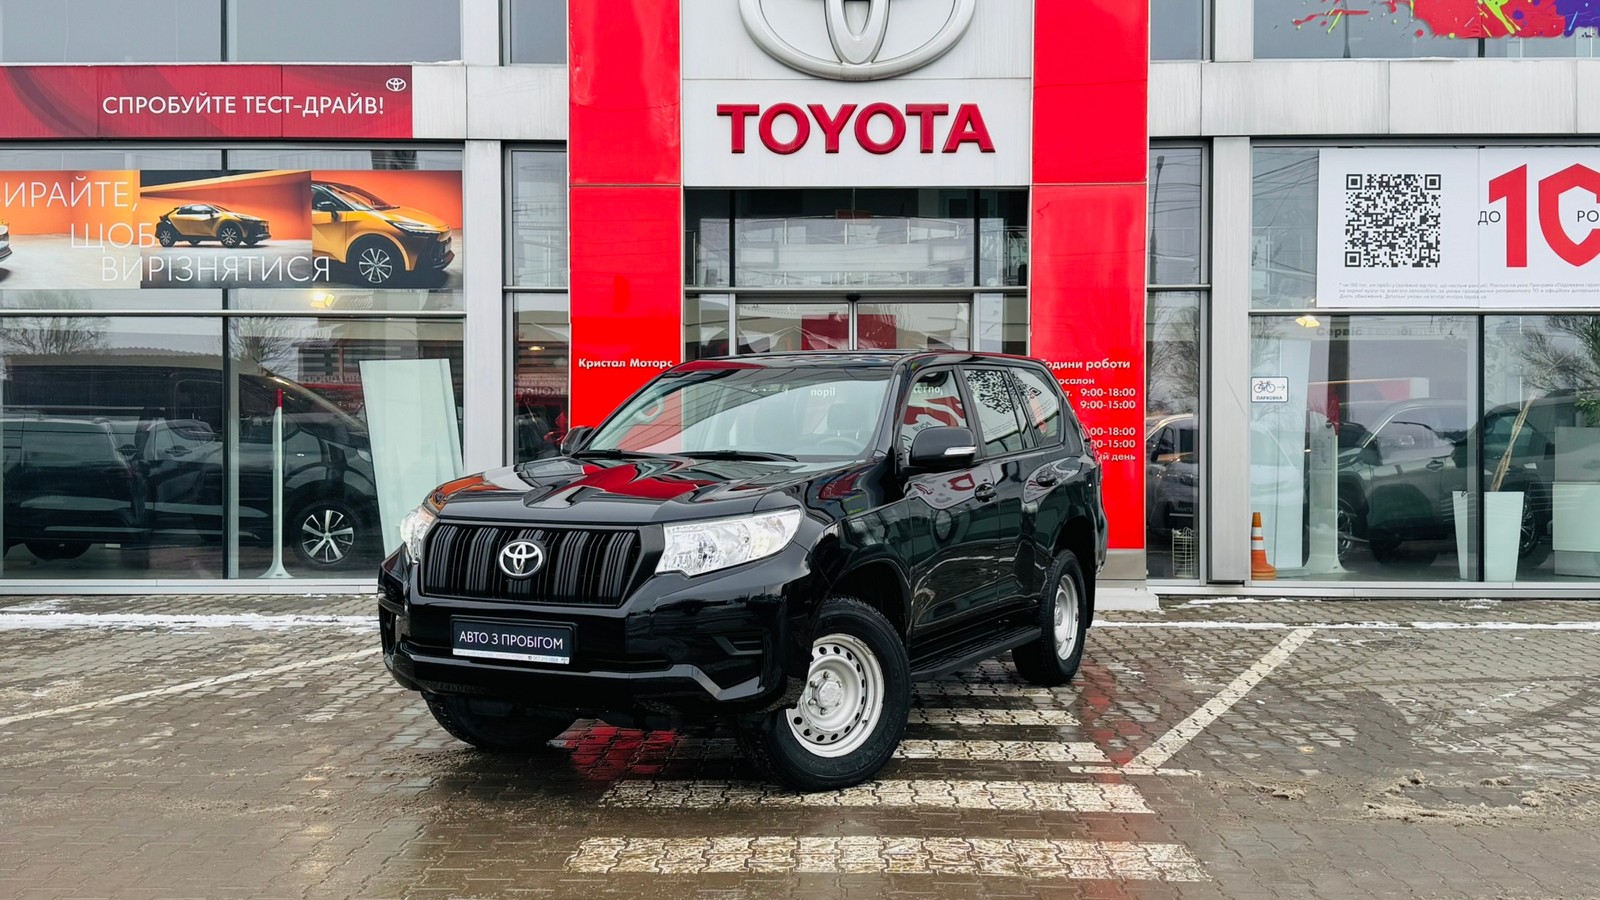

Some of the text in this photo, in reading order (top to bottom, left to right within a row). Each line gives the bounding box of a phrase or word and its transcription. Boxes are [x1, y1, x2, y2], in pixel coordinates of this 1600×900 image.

[102, 92, 384, 117] СПРОБУЙТЕ ТЕСТ-ДРАЙВ!
[716, 102, 996, 155] TOYOTA
[5, 176, 137, 212] ИРАЙТЕ,
[1478, 210, 1501, 226] ДО
[71, 222, 156, 253] ЩОБ
[102, 256, 331, 283] ВИРІЗНЯТИСЯ
[578, 358, 673, 370] Кристал Моторс
[1086, 358, 1131, 371] роботи
[1080, 388, 1136, 397] 9:00-18:00
[1080, 400, 1136, 409] 9:00-15:00
[1087, 427, 1136, 436] 00-18:00
[1111, 454, 1136, 462] день
[459, 631, 489, 644] АВТО
[501, 634, 564, 650] ПРОБІГОМ
